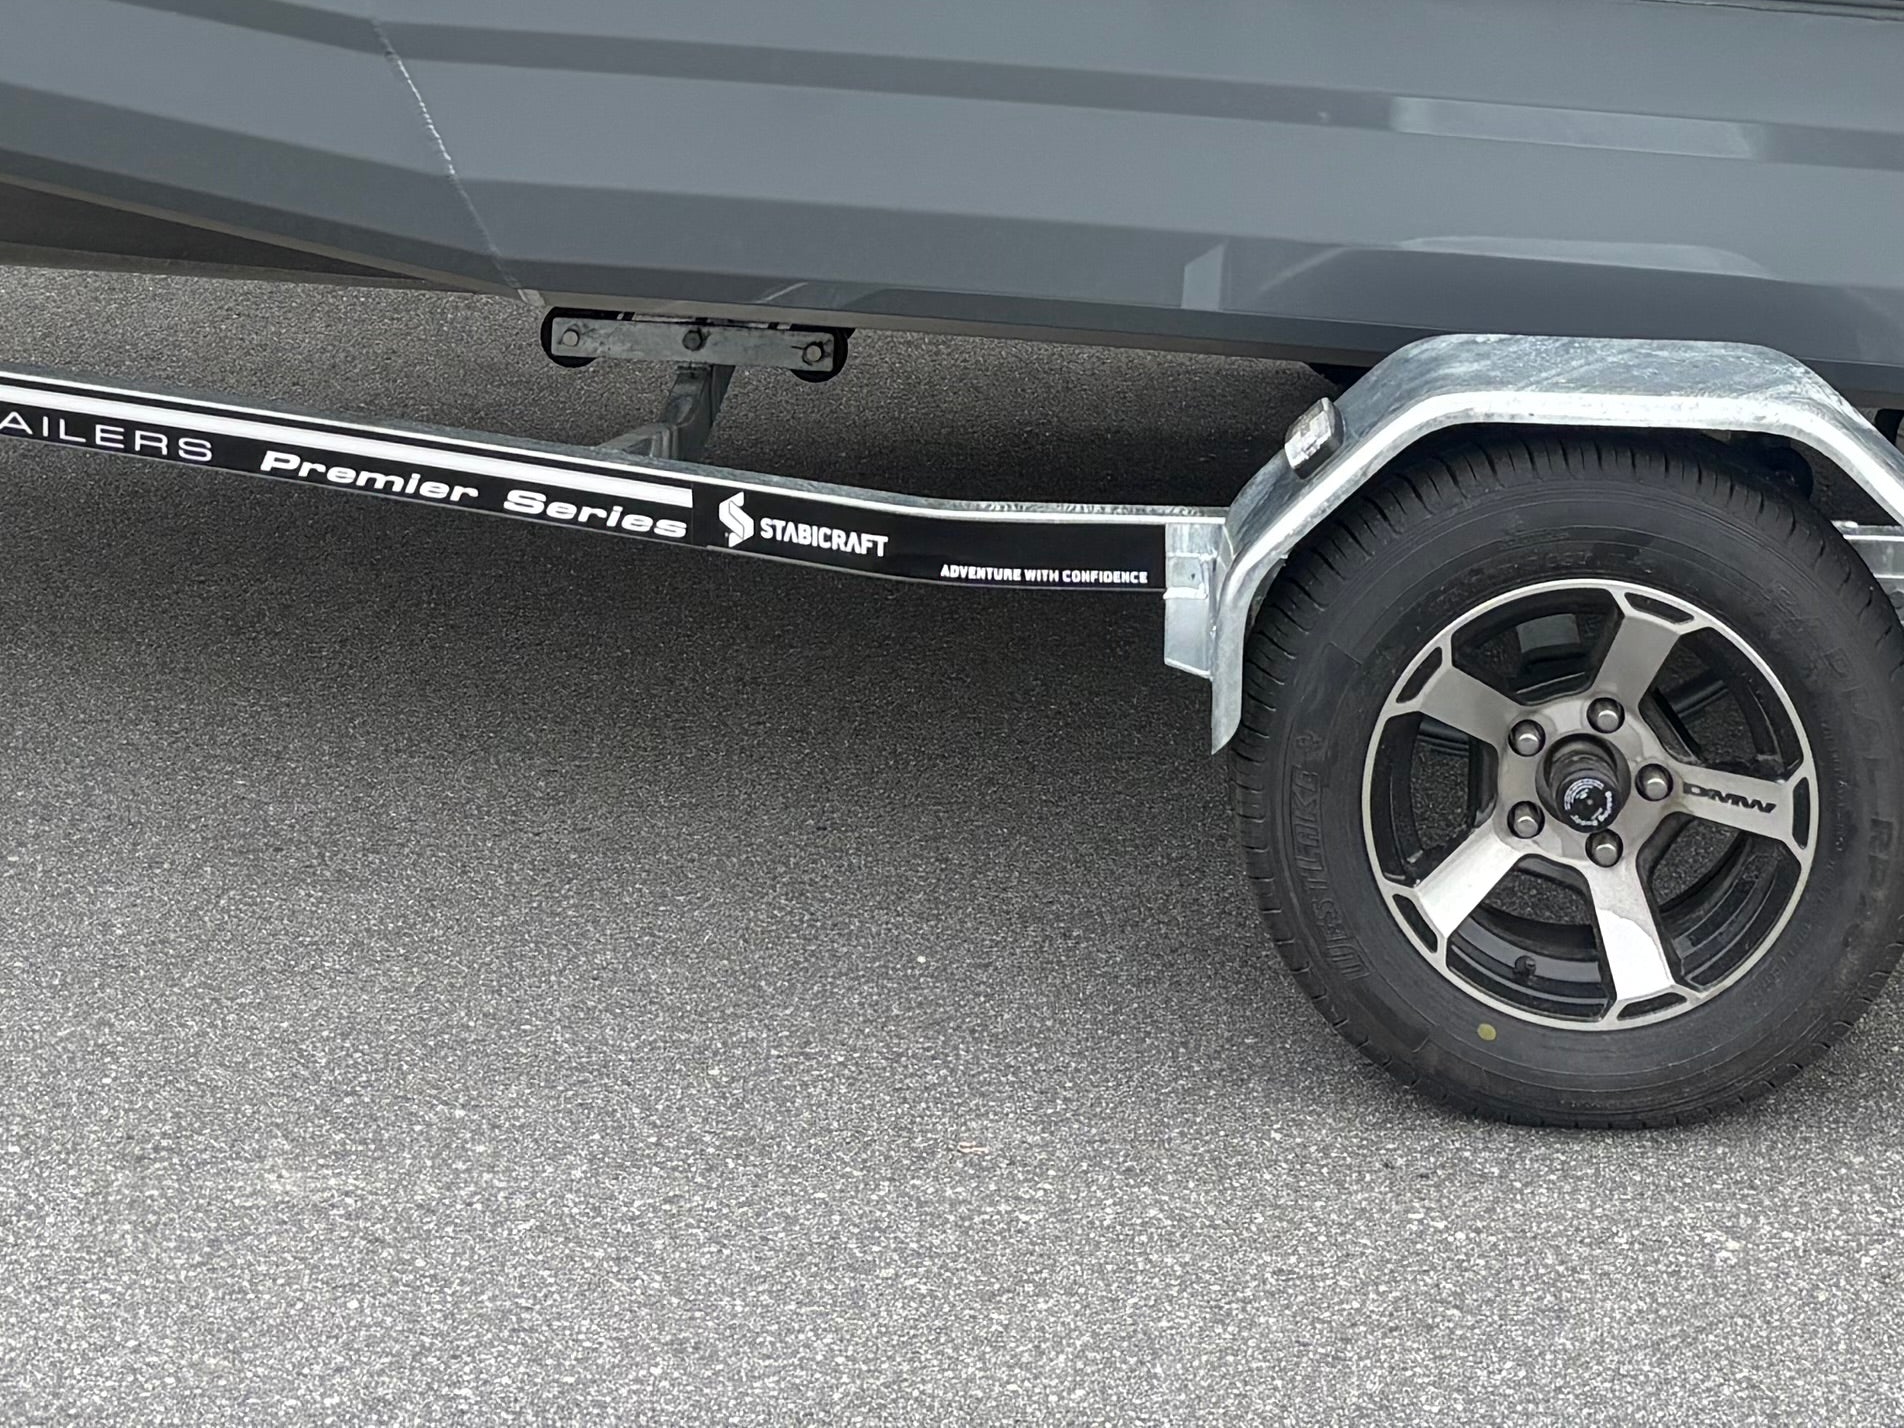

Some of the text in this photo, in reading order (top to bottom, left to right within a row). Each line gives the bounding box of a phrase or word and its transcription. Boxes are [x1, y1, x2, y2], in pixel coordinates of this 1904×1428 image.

[260, 450, 479, 503] Premier
[502, 489, 687, 539] Series
[759, 517, 1148, 585] STABICRAFT ADVENTURE WITH CONFIDENCE
[1683, 782, 1777, 814] DMW
